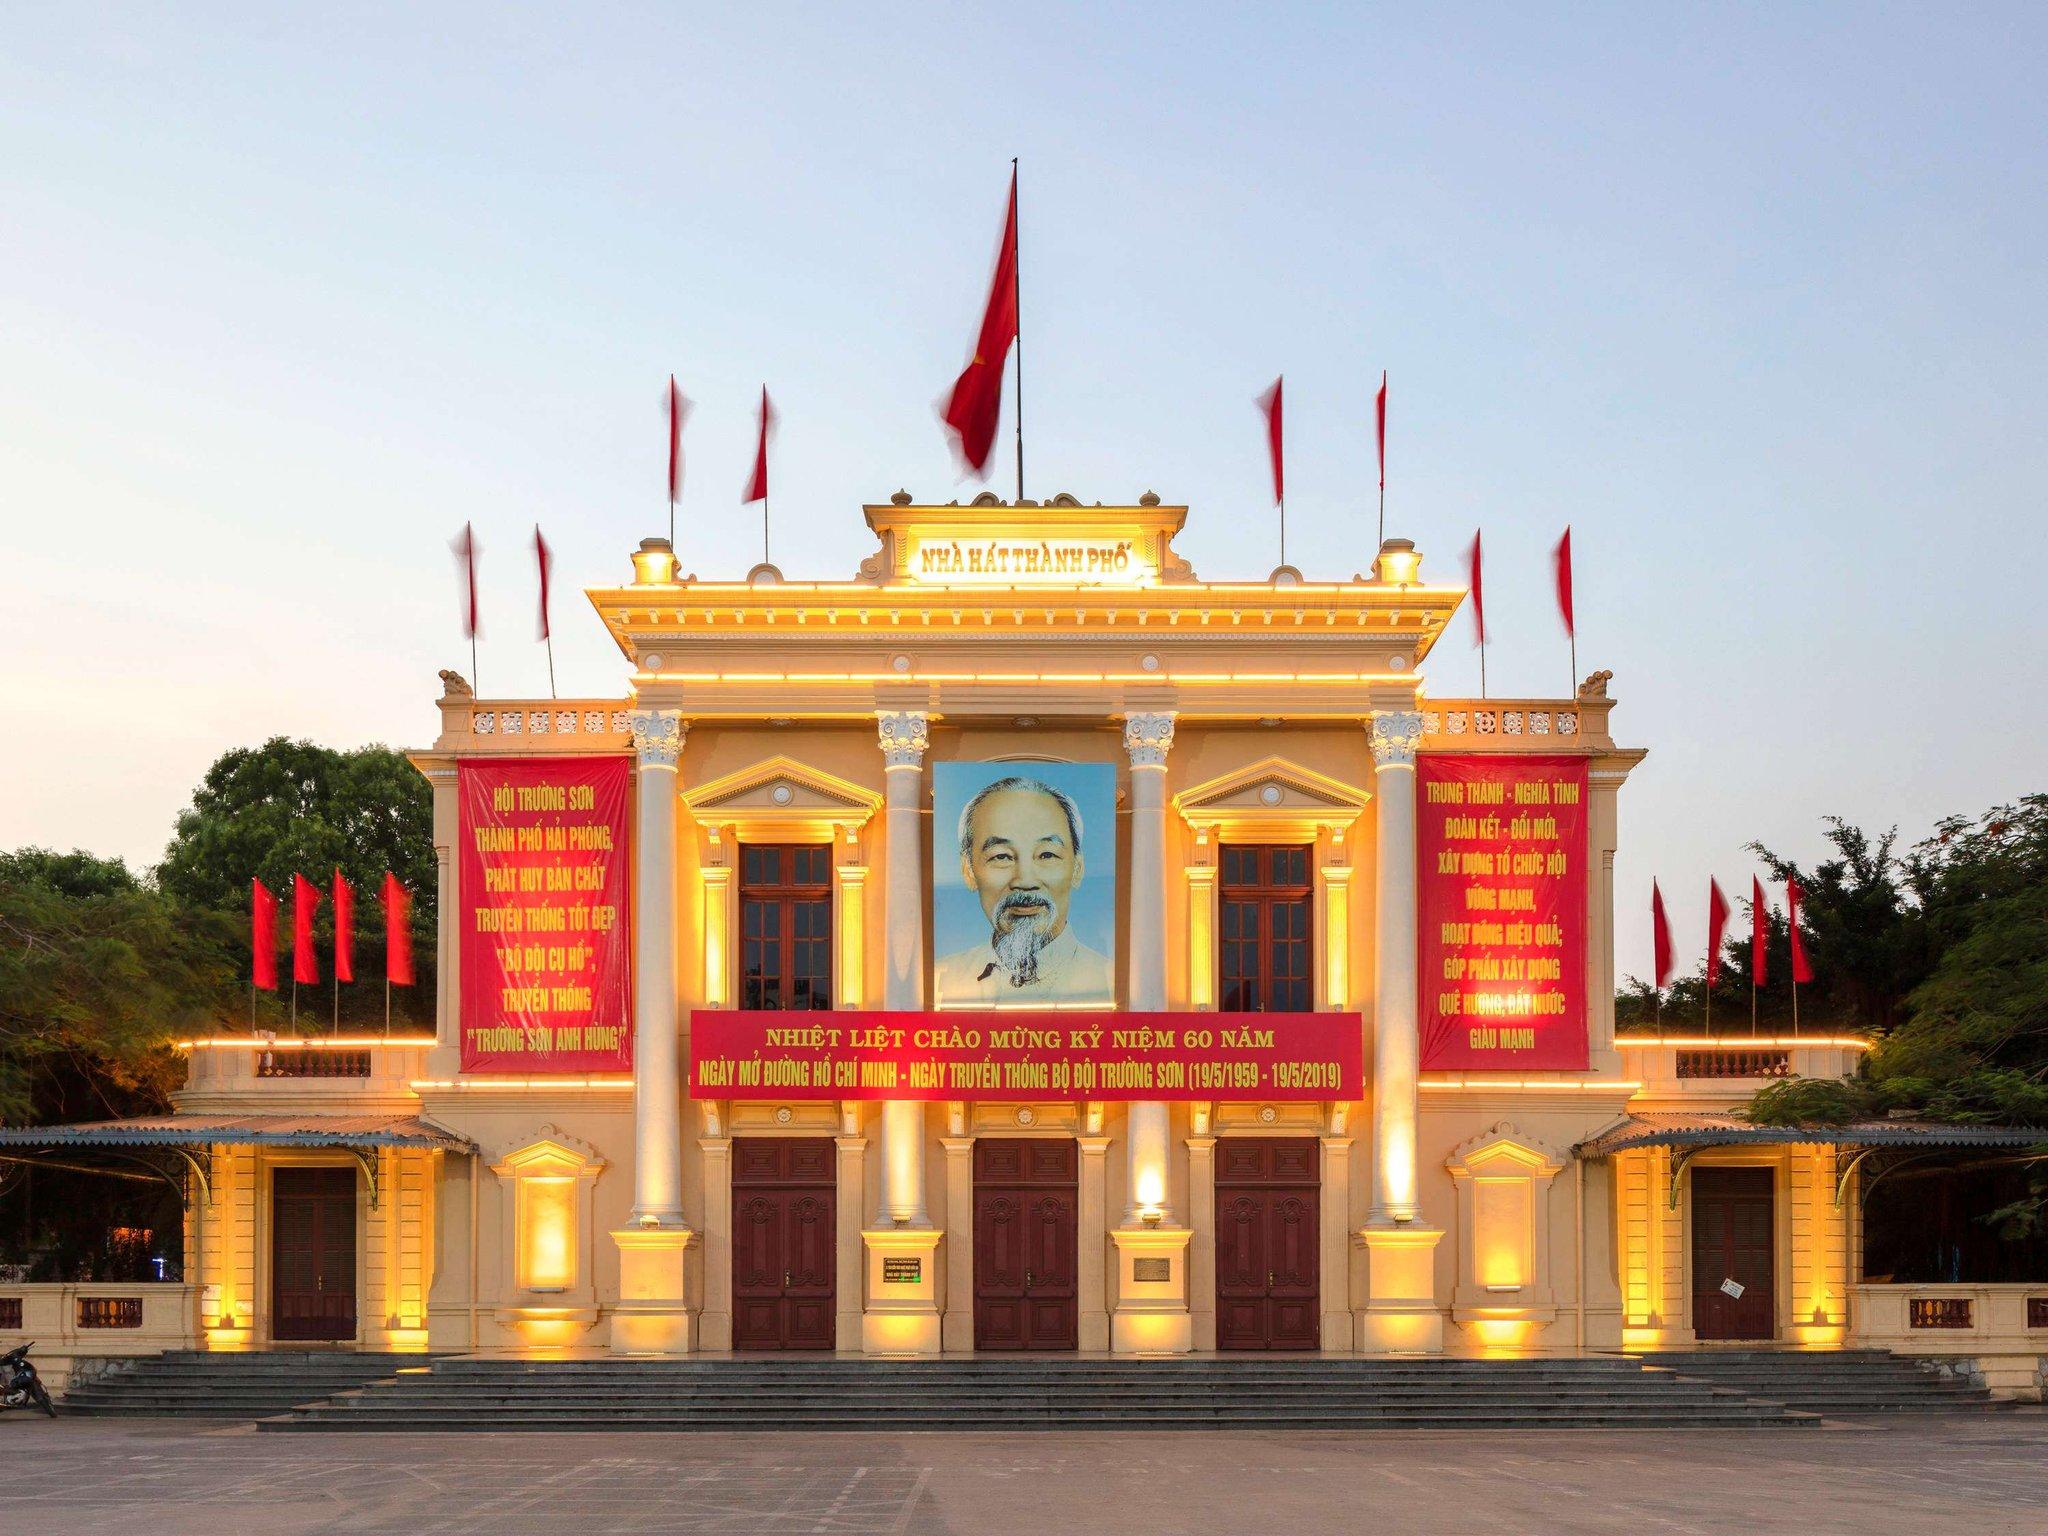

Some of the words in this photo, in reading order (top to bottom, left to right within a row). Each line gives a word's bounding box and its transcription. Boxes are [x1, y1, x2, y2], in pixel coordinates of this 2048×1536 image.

[922, 541, 964, 572] NHÀ
[968, 541, 1009, 572] HÁT
[1012, 541, 1083, 572] THÀNH
[1087, 541, 1132, 572] PHỐ
[494, 782, 514, 816] HỘI
[518, 780, 565, 811] TRƯỜNG
[569, 785, 594, 811] SƠN
[1426, 782, 1463, 803] TRUNG
[1467, 779, 1503, 804] THÀNH
[1515, 779, 1550, 804] NGHĨA
[1553, 779, 1579, 804] TÌNH
[475, 822, 515, 852] THÀNH
[518, 818, 543, 851] PHỐ
[546, 817, 566, 851] HẢI
[570, 820, 613, 852] PHÒNG,
[1445, 814, 1476, 839] ĐOÀN
[1479, 811, 1500, 840] KẾT
[1511, 810, 1530, 840] ĐỔI
[485, 863, 516, 892] PHÁT
[520, 867, 543, 892] HUY
[547, 857, 571, 891] BẢN
[575, 857, 606, 890] CHẤT
[1438, 848, 1460, 874] XÂY
[1462, 851, 1493, 879] DỰNG
[1496, 845, 1511, 875] TỔ
[1513, 848, 1544, 875] CHỨC
[1547, 849, 1566, 879] HỘI
[475, 900, 523, 932] TRUYỀN
[526, 899, 565, 932] THỐNG
[569, 898, 590, 931] TỐT
[592, 905, 616, 935] ĐẸP
[1441, 923, 1470, 949] HOẠT
[1472, 919, 1503, 950] ĐỘNG
[1505, 919, 1532, 950] HIỆU
[525, 943, 545, 976] ĐỘI
[549, 947, 565, 976] CỤ
[1444, 953, 1467, 980] GÓP
[1468, 951, 1500, 980] PHẦN
[1502, 954, 1525, 980] XÂY
[1527, 957, 1561, 985] DỰNG
[503, 979, 549, 1012] TRUYỀN
[552, 979, 591, 1011] THỐNG
[1439, 989, 1460, 1016] QUÊ
[1507, 987, 1531, 1015] ĐẤT
[1533, 987, 1565, 1015] NƯỚC
[528, 1027, 552, 1051] SƠN
[556, 1027, 581, 1051] ANH
[766, 1024, 842, 1051] NHIỆT
[850, 1024, 906, 1052] LIỆT
[914, 1025, 981, 1048] CHÀO
[989, 1025, 1062, 1048] MỪNG
[1070, 1024, 1104, 1048] KỶ
[1112, 1025, 1176, 1052] NIỆM
[1183, 1030, 1212, 1048] 60
[1220, 1025, 1275, 1048] NĂM
[1469, 1024, 1496, 1049] GIÀU
[1500, 1028, 1534, 1053] MẠNH
[699, 1055, 735, 1086] NGÀY
[739, 1050, 762, 1086] MỞ
[764, 1053, 809, 1087] ĐƯỜNG
[813, 1052, 831, 1087] HỒ
[835, 1056, 858, 1087] CHÍ
[861, 1060, 897, 1088] MINH
[910, 1056, 946, 1088] NGÀY
[950, 1053, 1000, 1088] TRUYỀN
[1004, 1054, 1048, 1089] THỐNG
[1052, 1057, 1071, 1094] BỘ
[1074, 1057, 1096, 1094] ĐỘI
[1100, 1055, 1153, 1089] TRƯỜNG
[1156, 1060, 1185, 1089] SƠN
[1188, 1062, 1258, 1091] (19/5/1959
[1271, 1062, 1341, 1091] 19/5/2019)
